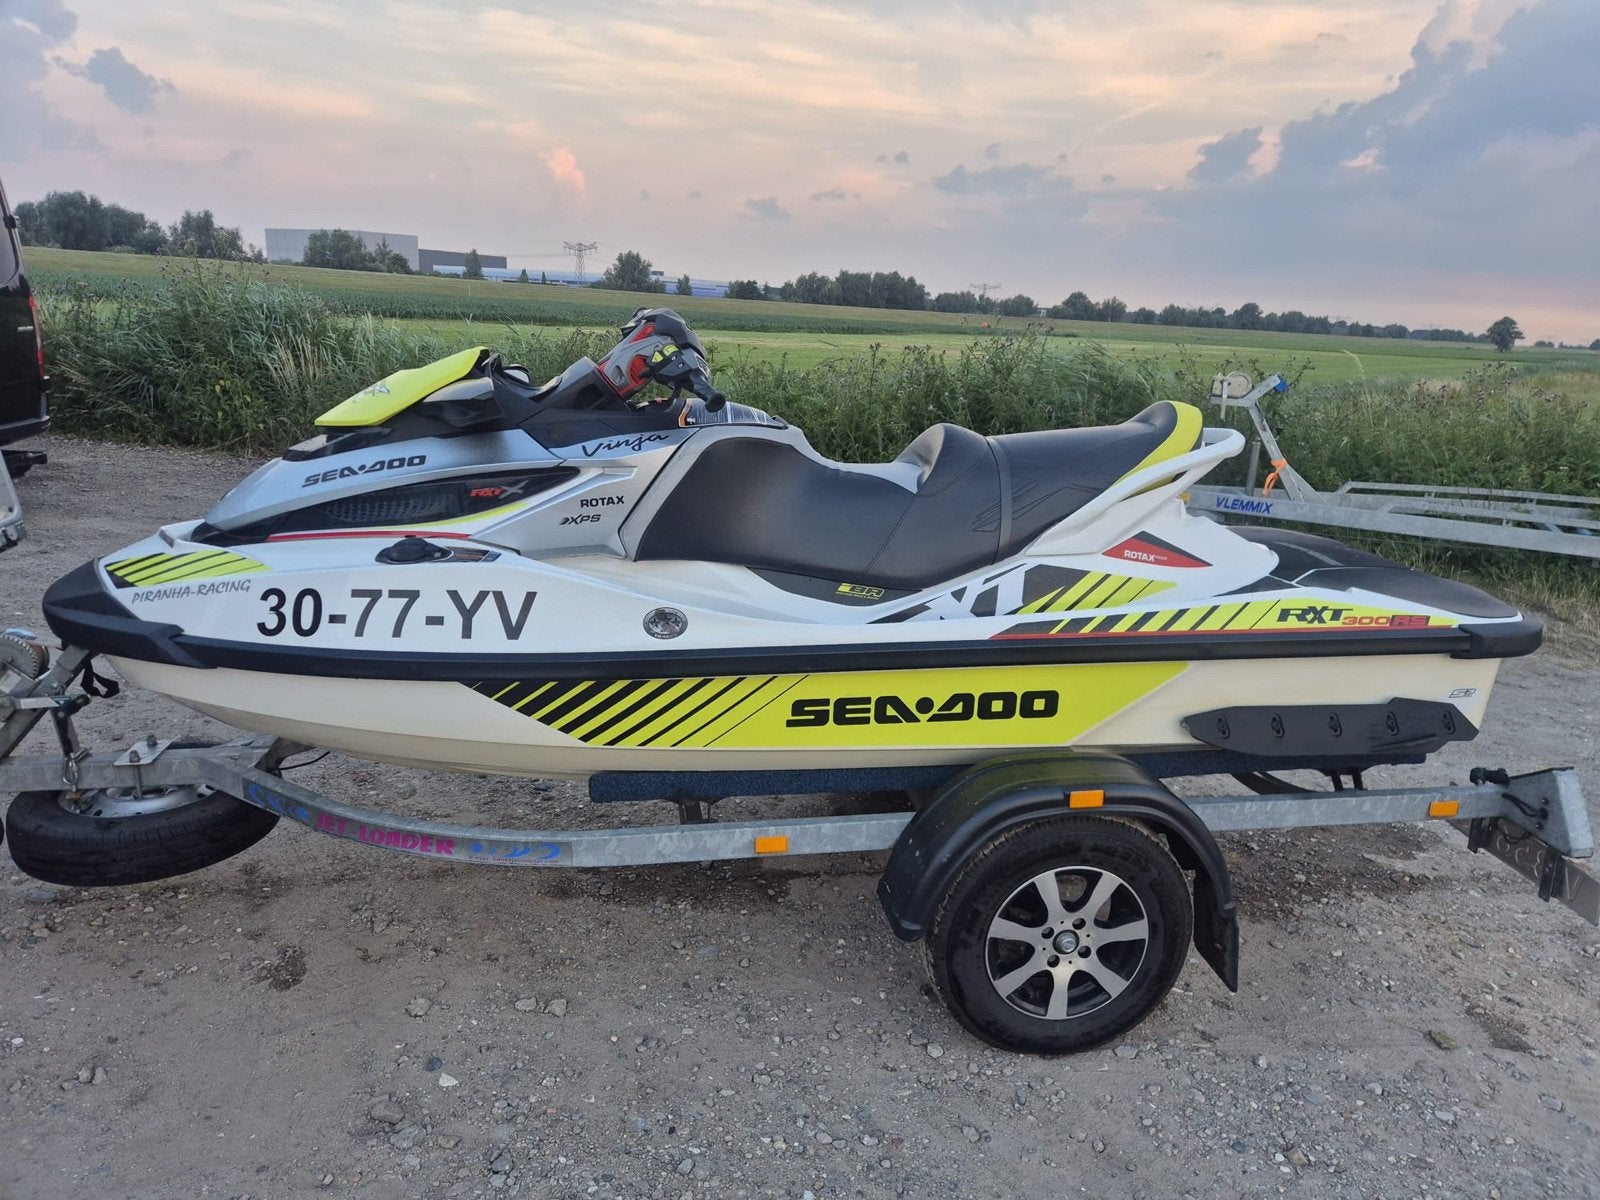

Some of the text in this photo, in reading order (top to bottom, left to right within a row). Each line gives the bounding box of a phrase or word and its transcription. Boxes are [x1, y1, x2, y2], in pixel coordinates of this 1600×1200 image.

[581, 433, 670, 457] Vinja
[580, 495, 625, 508] ROTAX
[1216, 496, 1274, 514] VLEMMIX
[567, 513, 602, 525] XPS
[1124, 550, 1155, 562] ROTAX
[131, 579, 252, 604] PIRANHA-RACING
[256, 588, 538, 641] 30-77-YV
[1277, 605, 1354, 625] RXT
